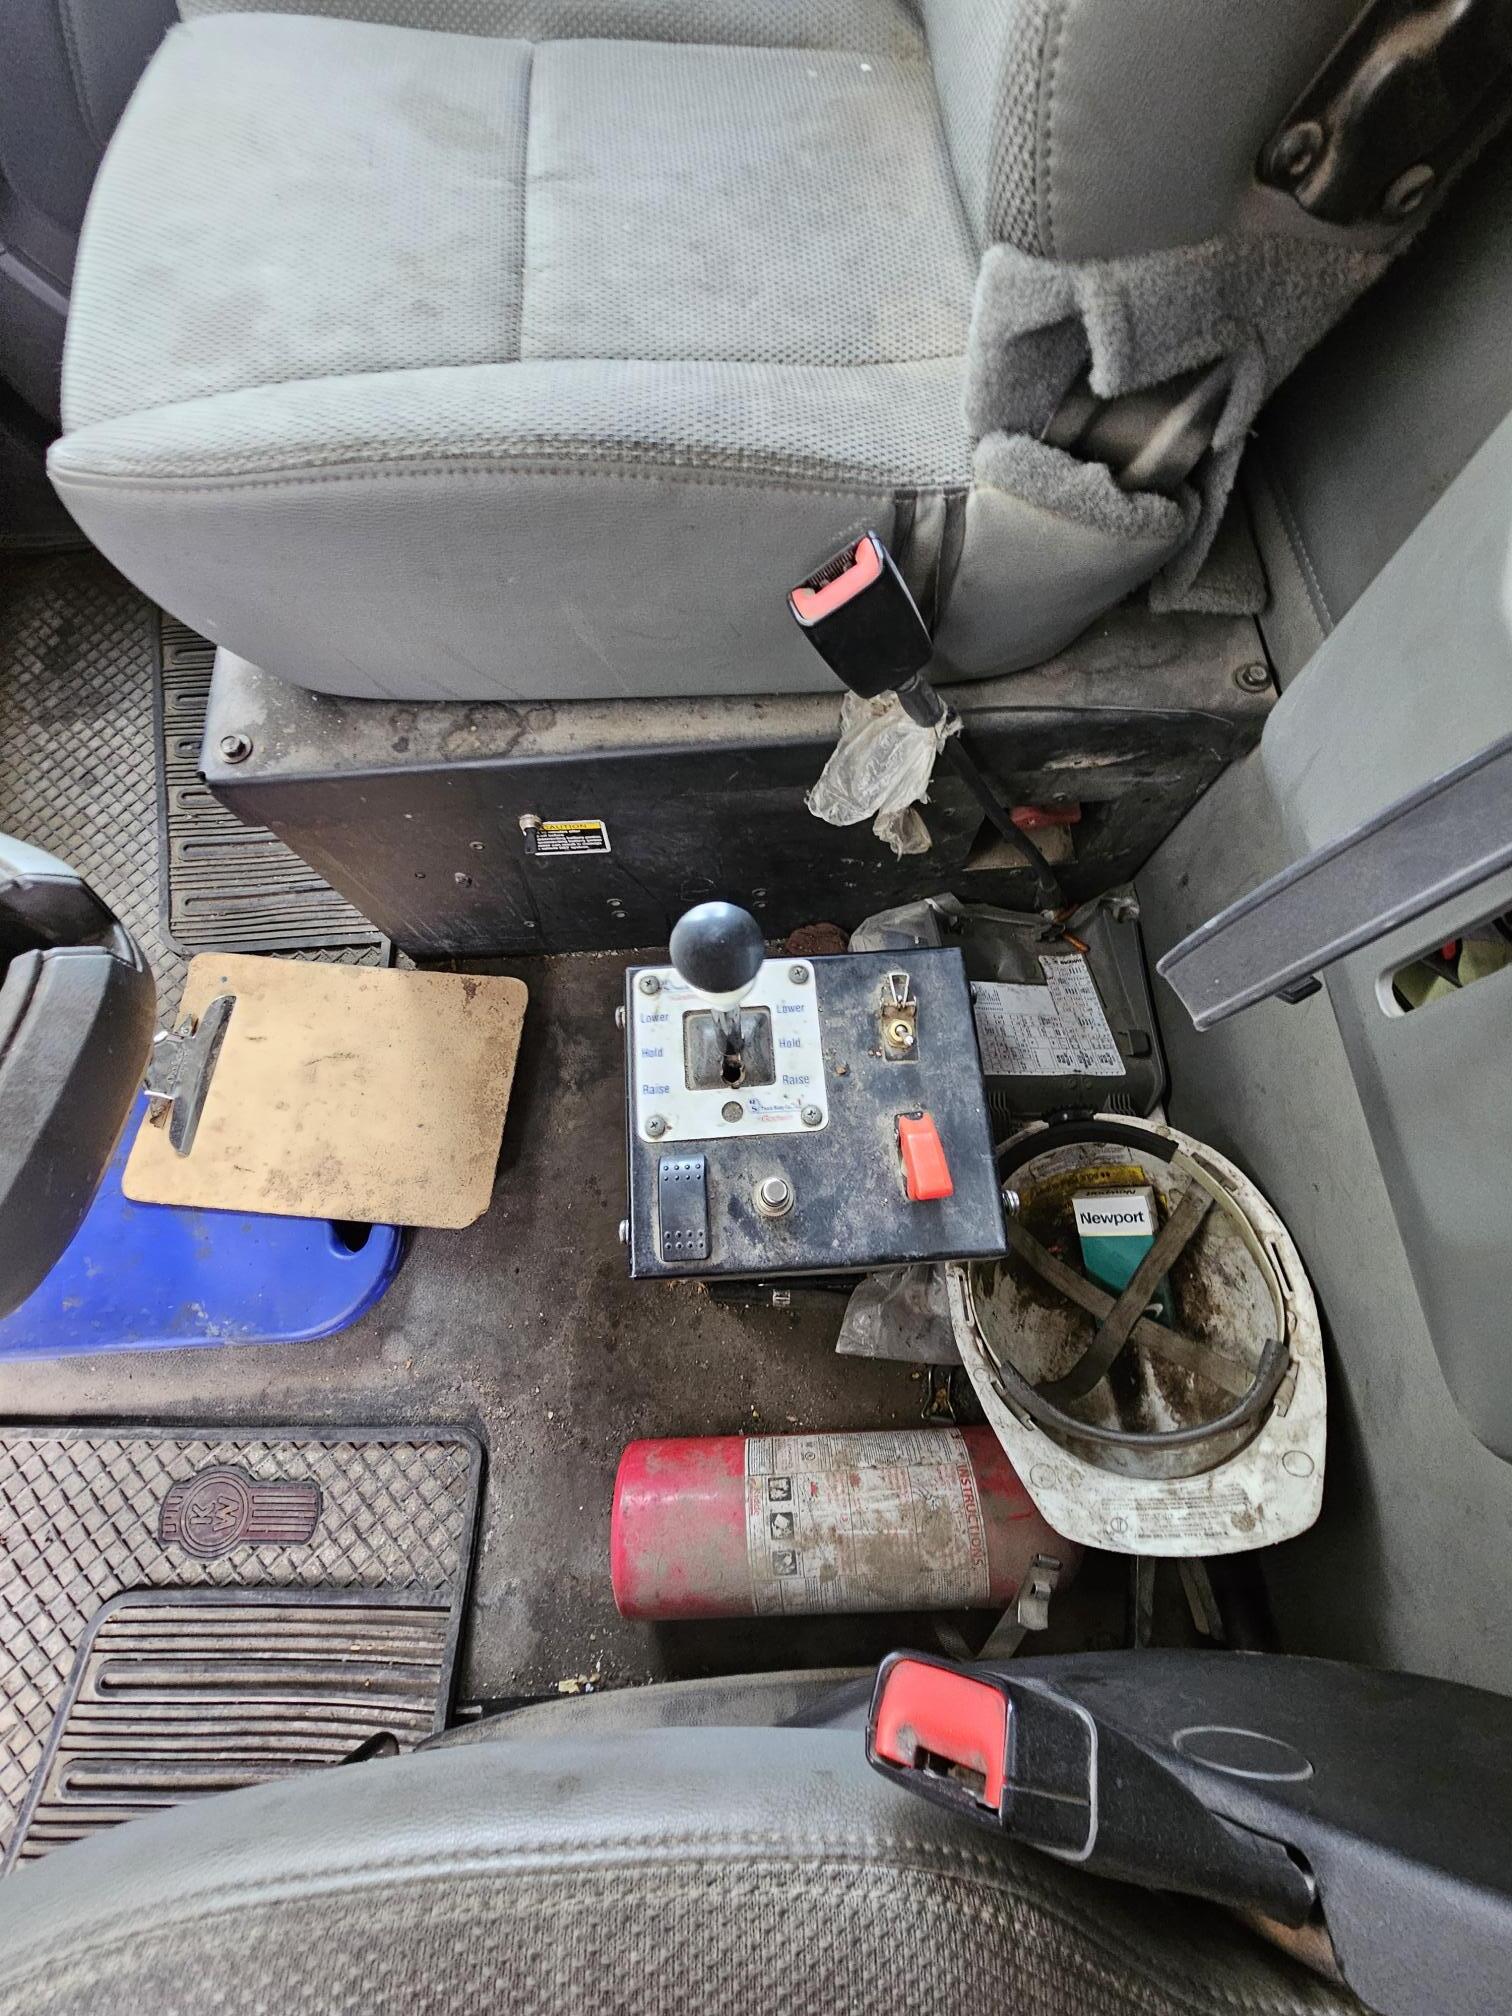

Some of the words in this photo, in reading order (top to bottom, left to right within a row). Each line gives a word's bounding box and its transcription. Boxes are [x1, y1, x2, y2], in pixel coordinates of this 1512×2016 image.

[776, 1004, 805, 1014] Lower
[640, 1013, 669, 1024] Lower
[779, 1038, 800, 1048] Hold
[641, 1048, 663, 1058] Hold
[782, 1074, 810, 1085] Raise
[642, 1084, 670, 1094] Raise
[1080, 1211, 1144, 1226] Newport
[957, 1464, 984, 1566] INSTRUCTIONS
